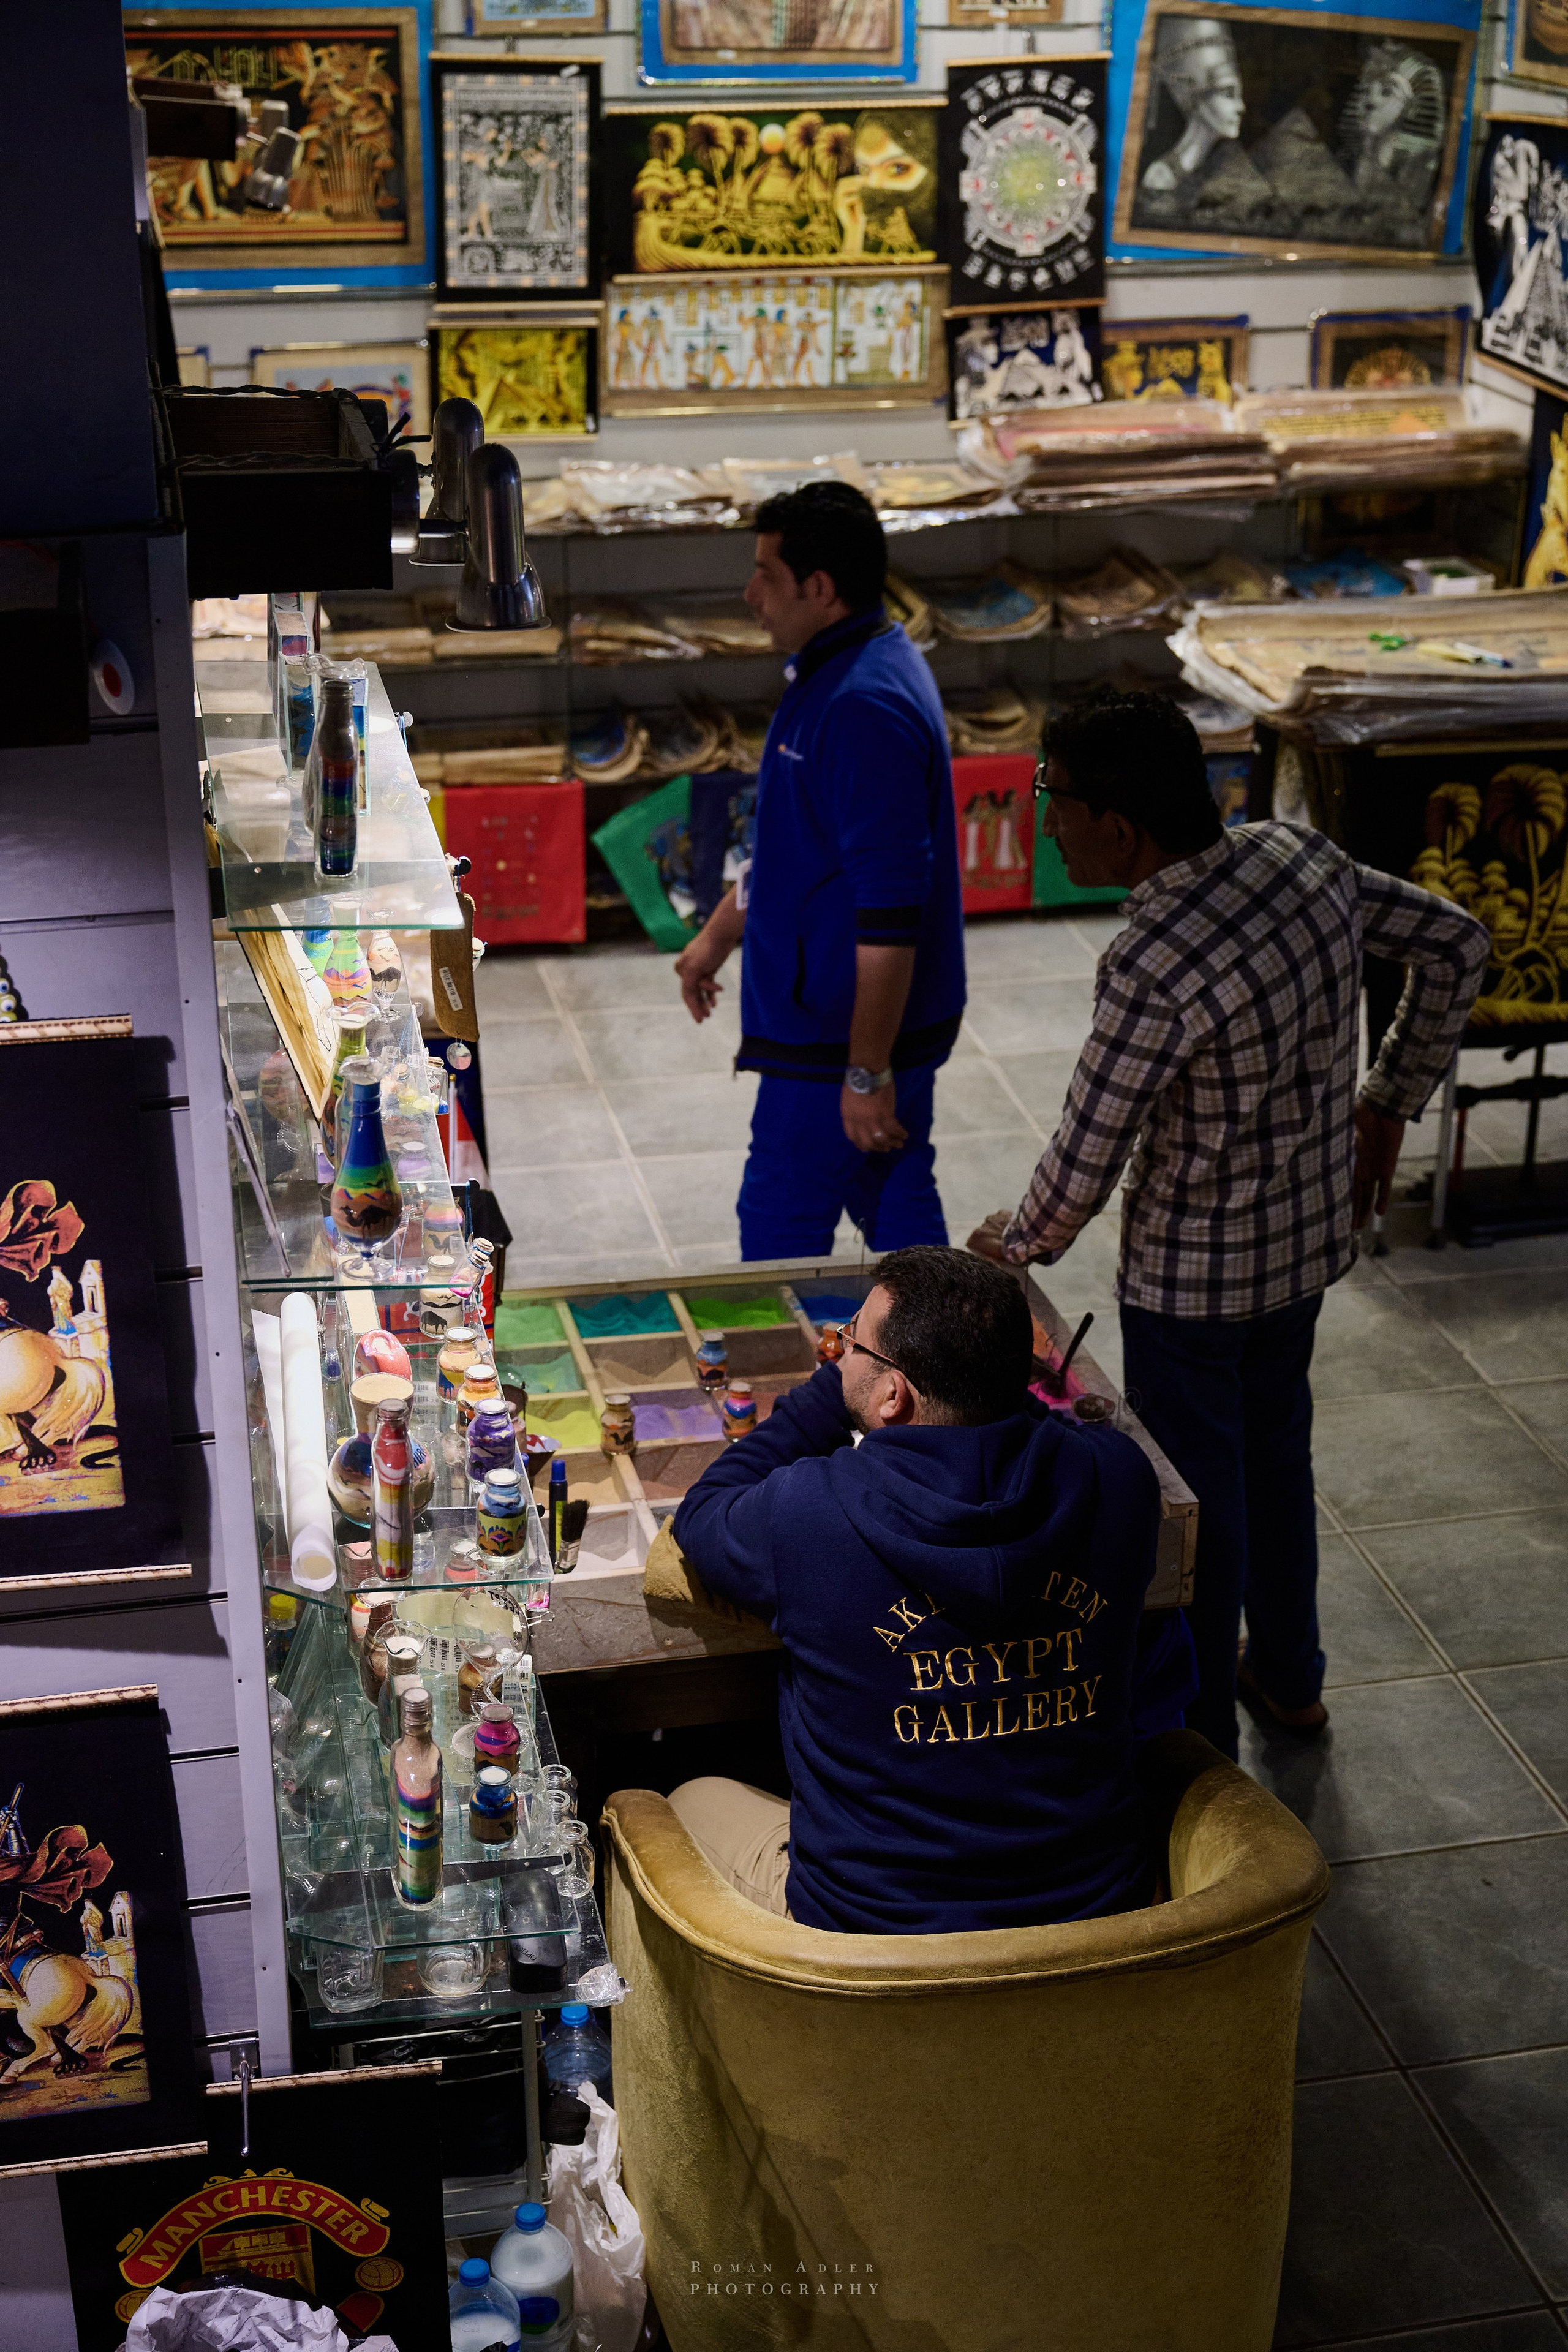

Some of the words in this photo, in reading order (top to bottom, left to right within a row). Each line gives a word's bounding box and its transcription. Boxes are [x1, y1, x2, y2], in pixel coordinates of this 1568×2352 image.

[903, 1628, 1083, 1691] EGYPT
[894, 1675, 1103, 1743] GALLERY
[140, 2185, 370, 2269] MANCHESTER
